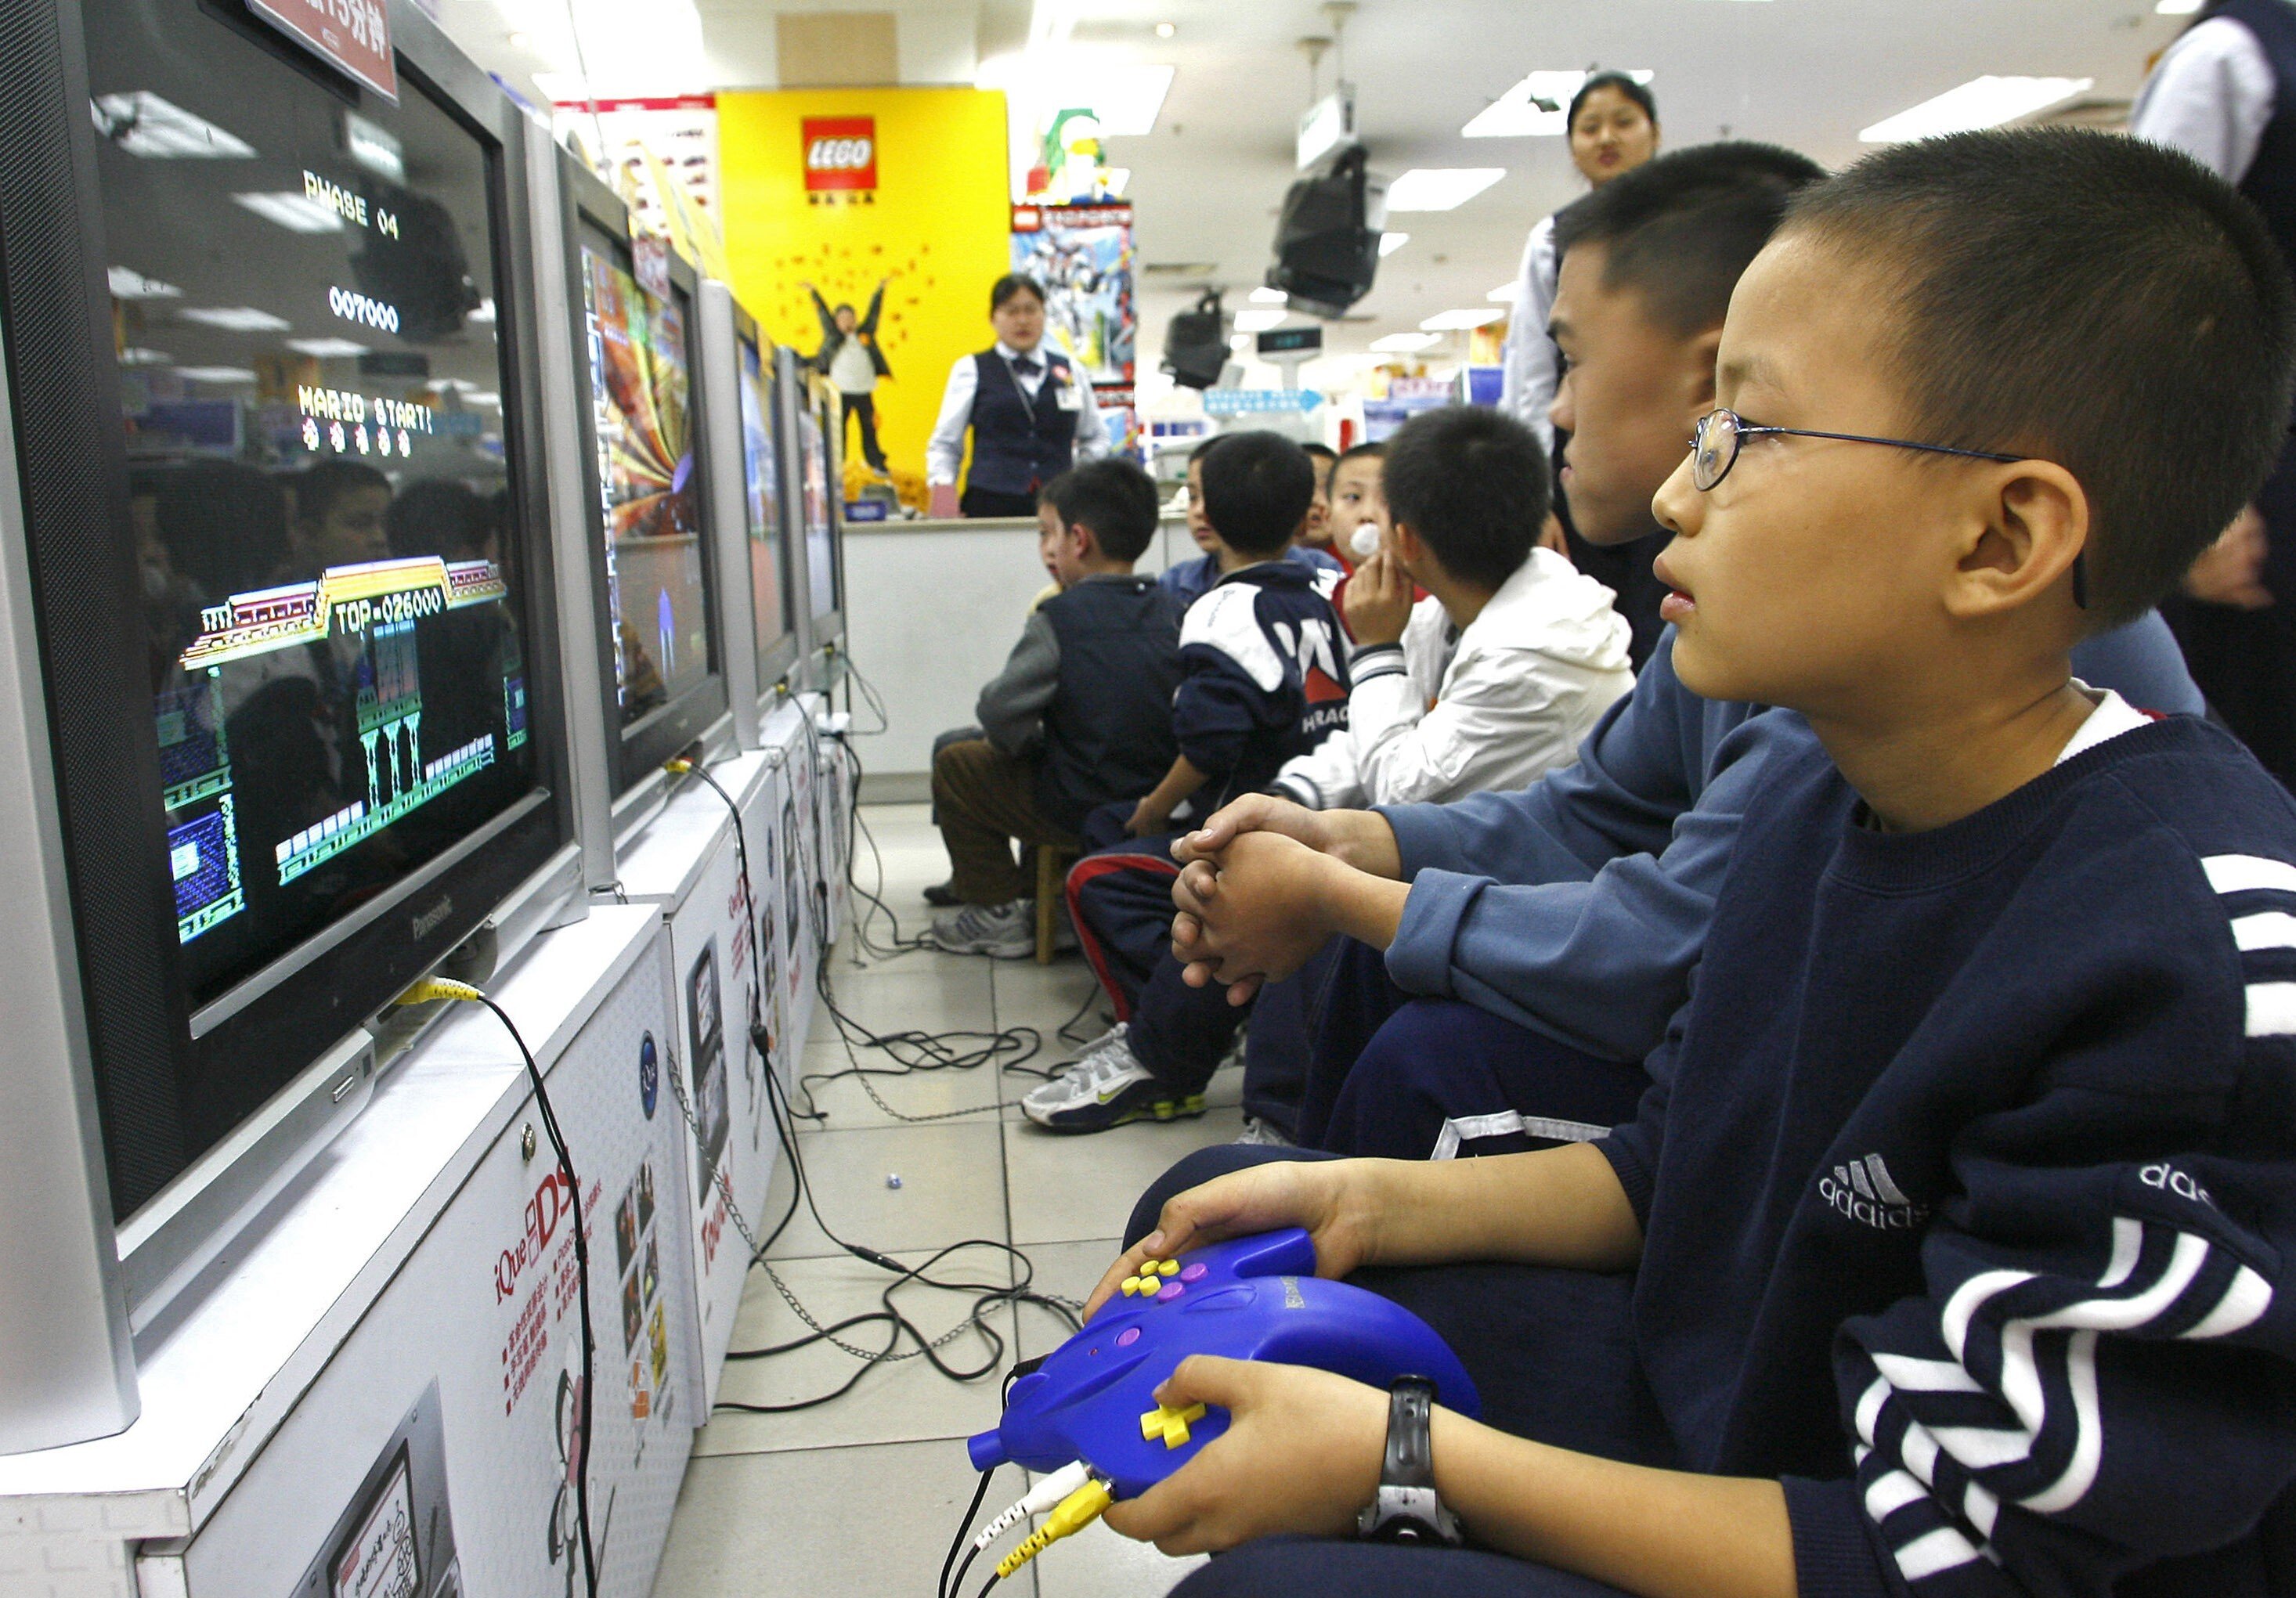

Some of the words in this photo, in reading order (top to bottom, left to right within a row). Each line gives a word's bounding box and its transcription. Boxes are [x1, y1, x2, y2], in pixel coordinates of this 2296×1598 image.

[807, 138, 872, 170] LEGO
[302, 169, 368, 228] PHASE
[377, 207, 399, 241] 04
[329, 286, 399, 334] 007000
[298, 384, 366, 424] MARIO
[374, 397, 433, 435] START!
